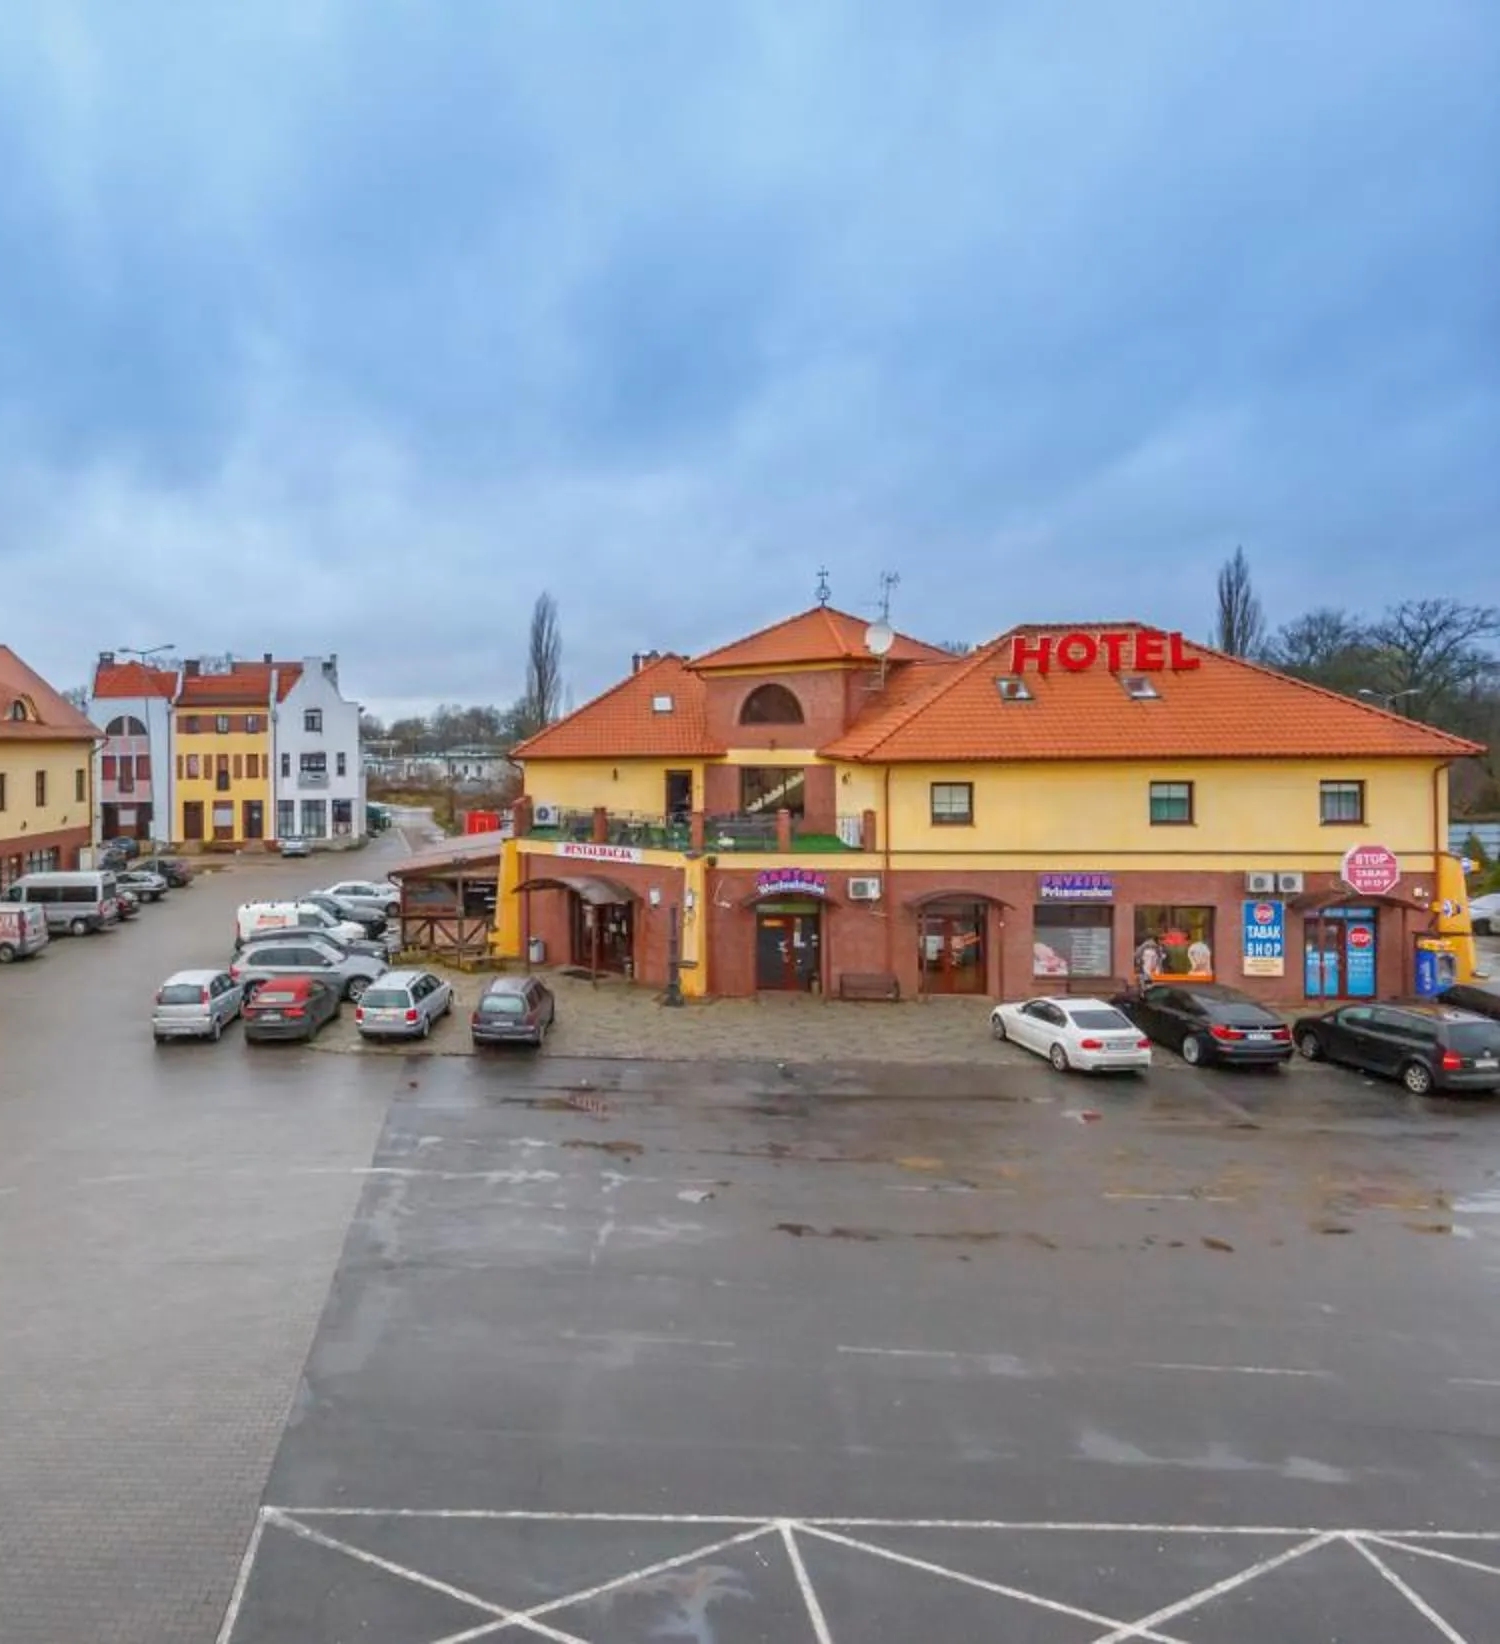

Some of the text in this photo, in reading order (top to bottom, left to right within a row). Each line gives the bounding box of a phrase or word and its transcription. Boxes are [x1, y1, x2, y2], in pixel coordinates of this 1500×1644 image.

[1011, 631, 1200, 675] HOTEL
[1355, 853, 1389, 865] STOP
[1246, 925, 1281, 939] TABAK
[1350, 932, 1371, 943] STOP
[1247, 942, 1281, 957] SHOP
